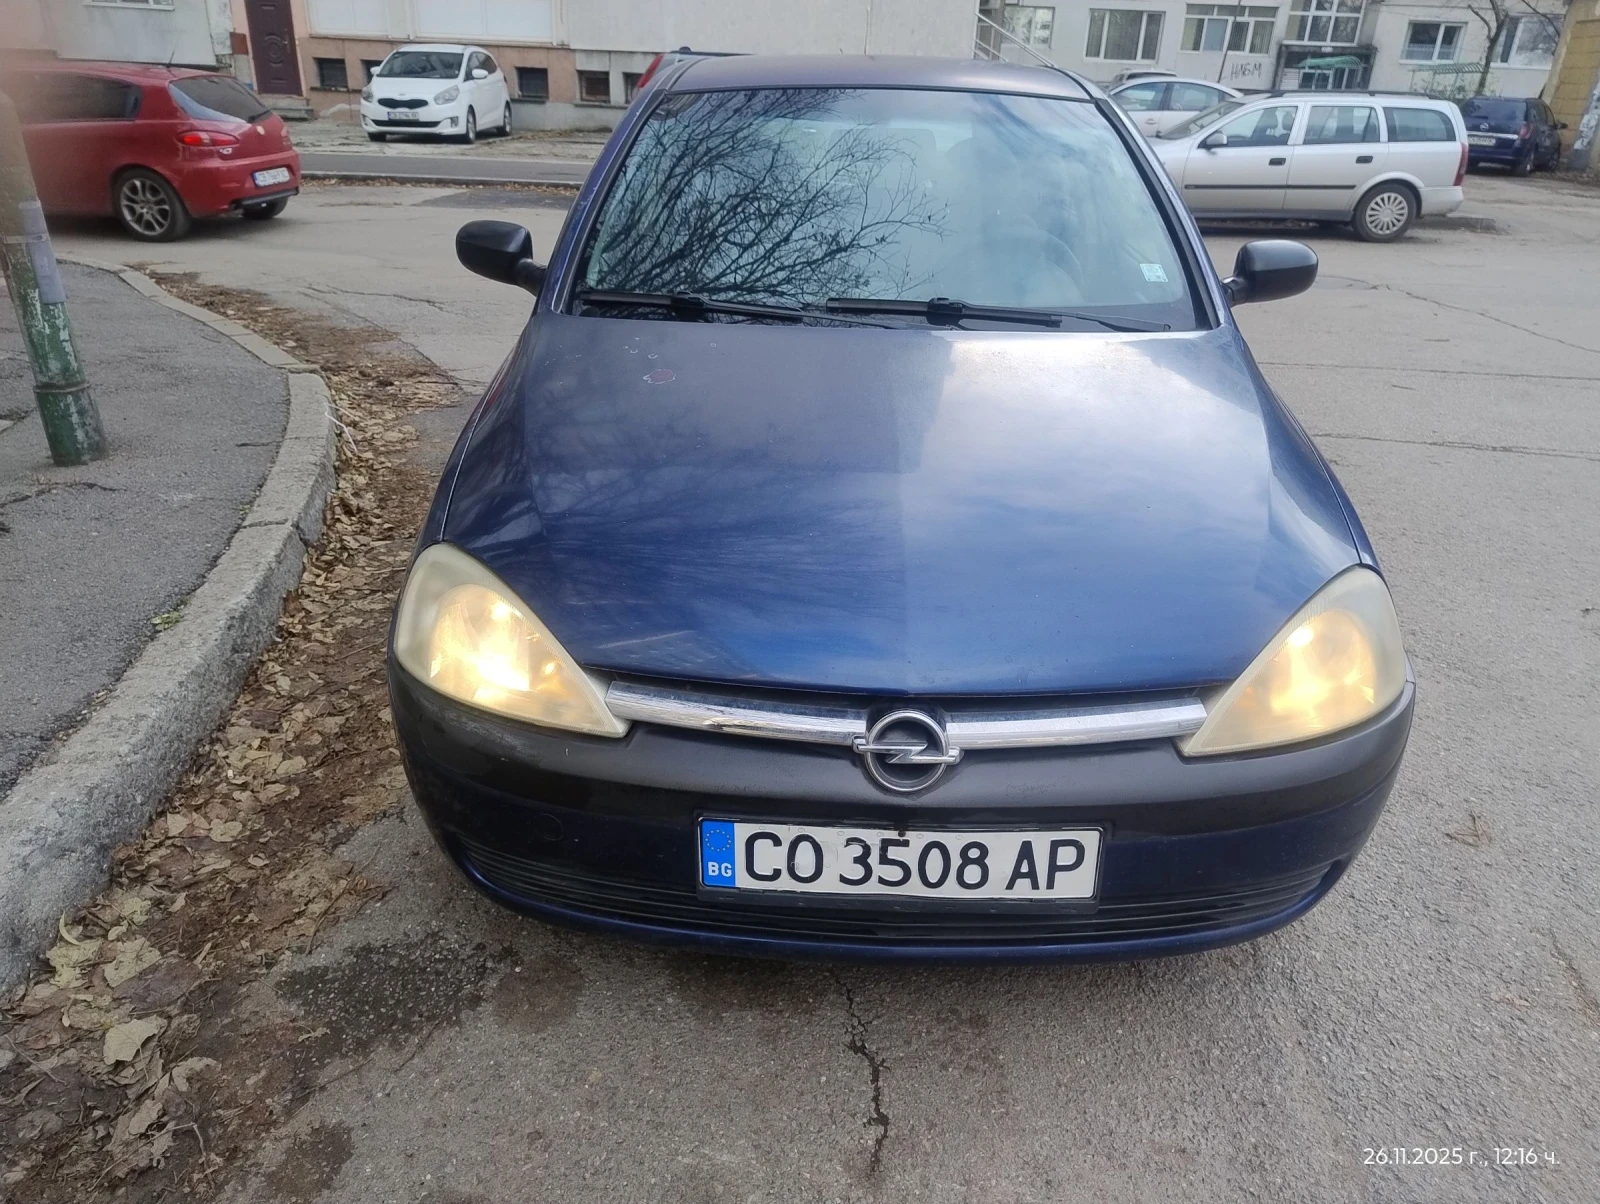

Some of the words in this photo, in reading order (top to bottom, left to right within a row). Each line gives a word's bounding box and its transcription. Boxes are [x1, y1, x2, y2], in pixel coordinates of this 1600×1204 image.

[708, 861, 732, 877] BG
[744, 831, 824, 884] CO
[838, 836, 990, 891] 3508
[1004, 838, 1086, 891] AP
